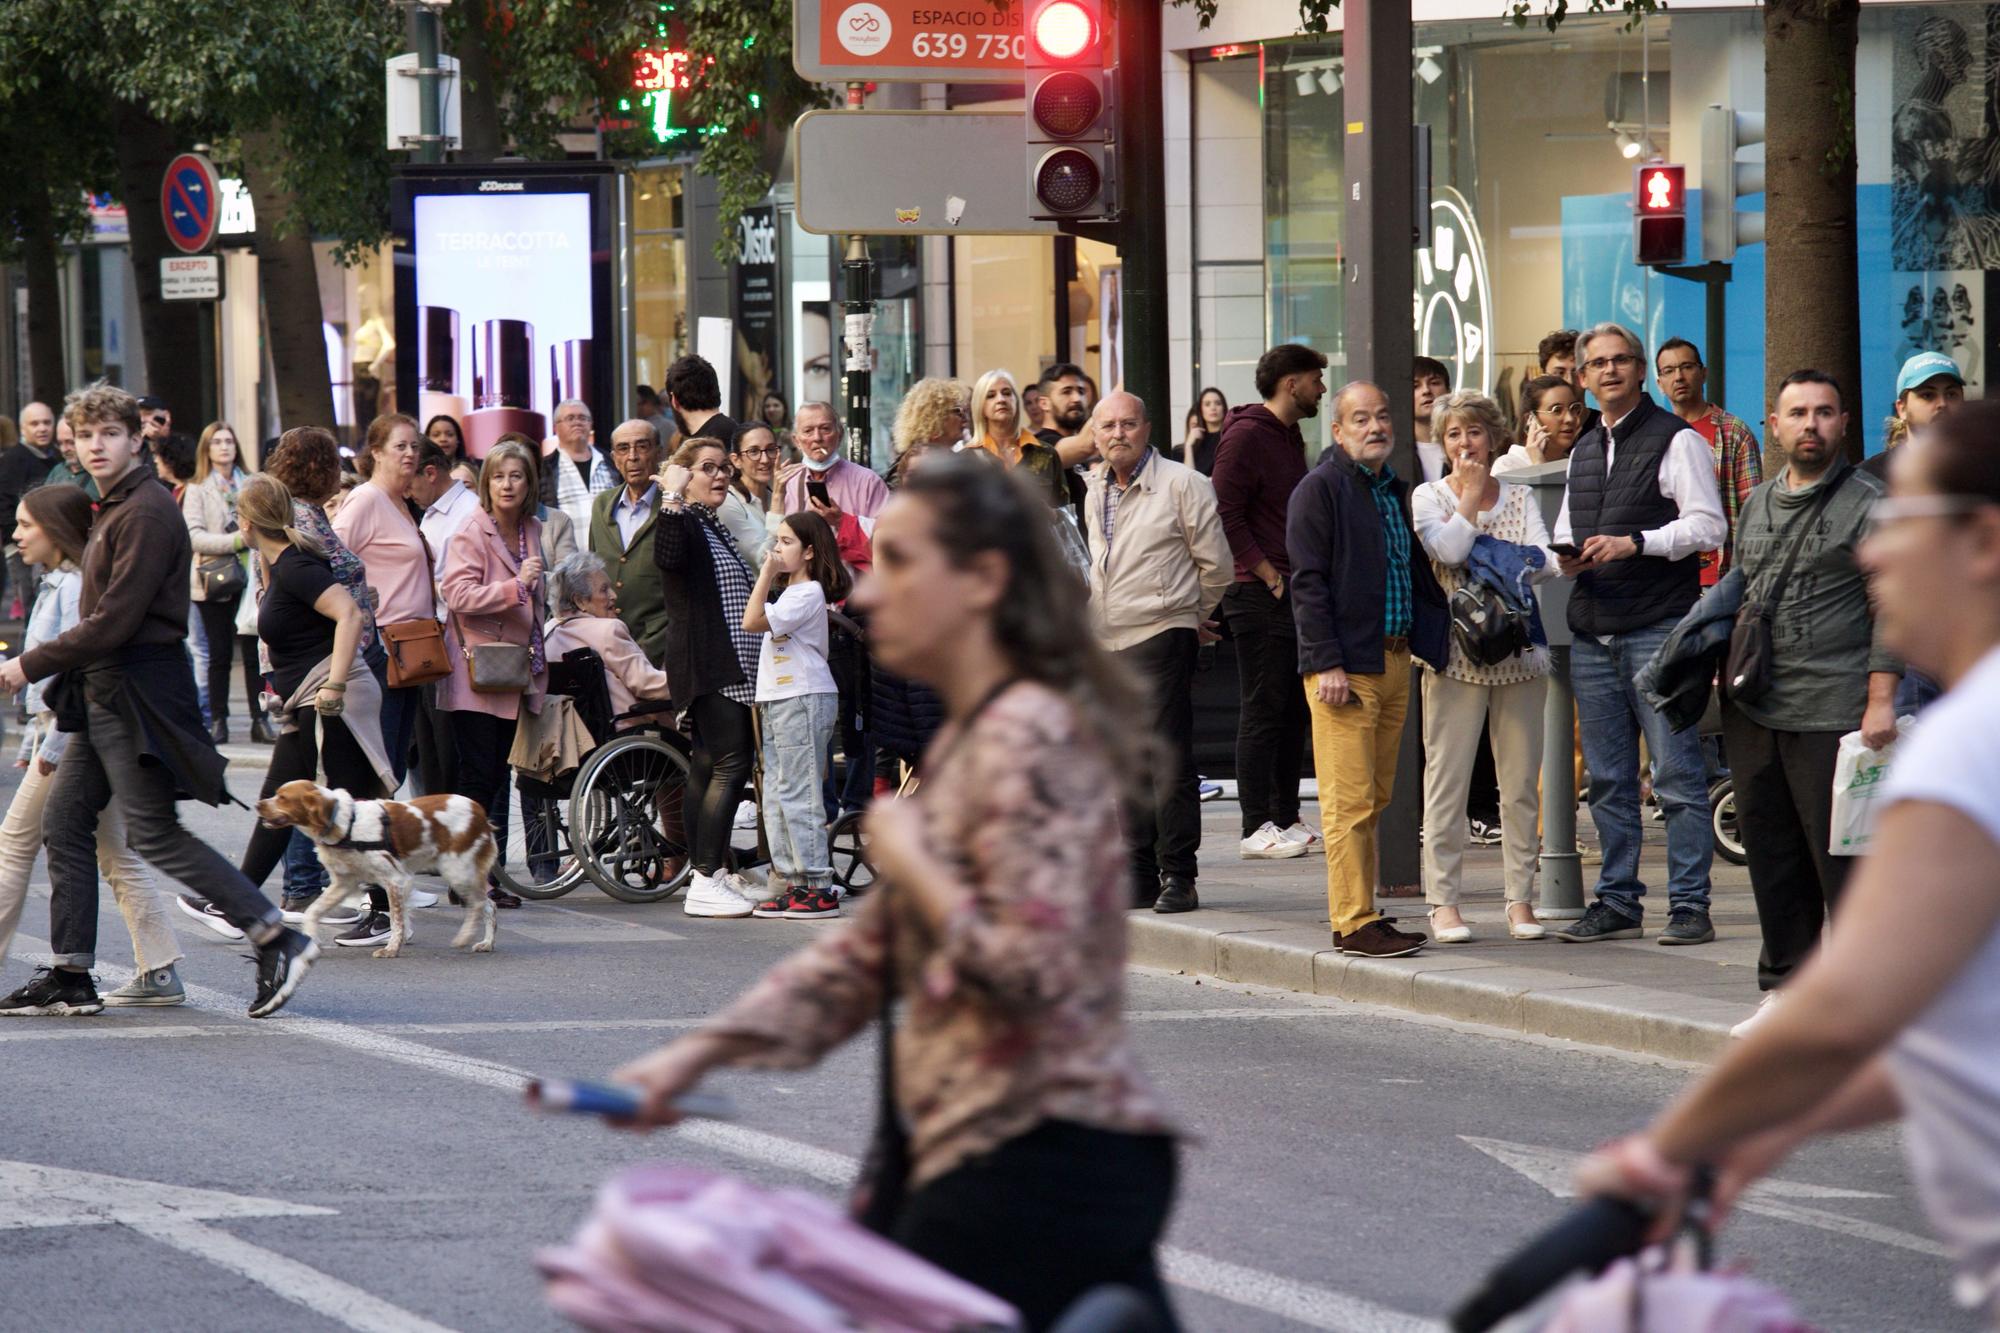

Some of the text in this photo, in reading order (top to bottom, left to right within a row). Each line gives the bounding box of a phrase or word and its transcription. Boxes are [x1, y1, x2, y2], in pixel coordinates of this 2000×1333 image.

[912, 10, 986, 26] ESPACIO
[912, 32, 1025, 60] 639 730
[435, 231, 570, 251] TERRACOTTA
